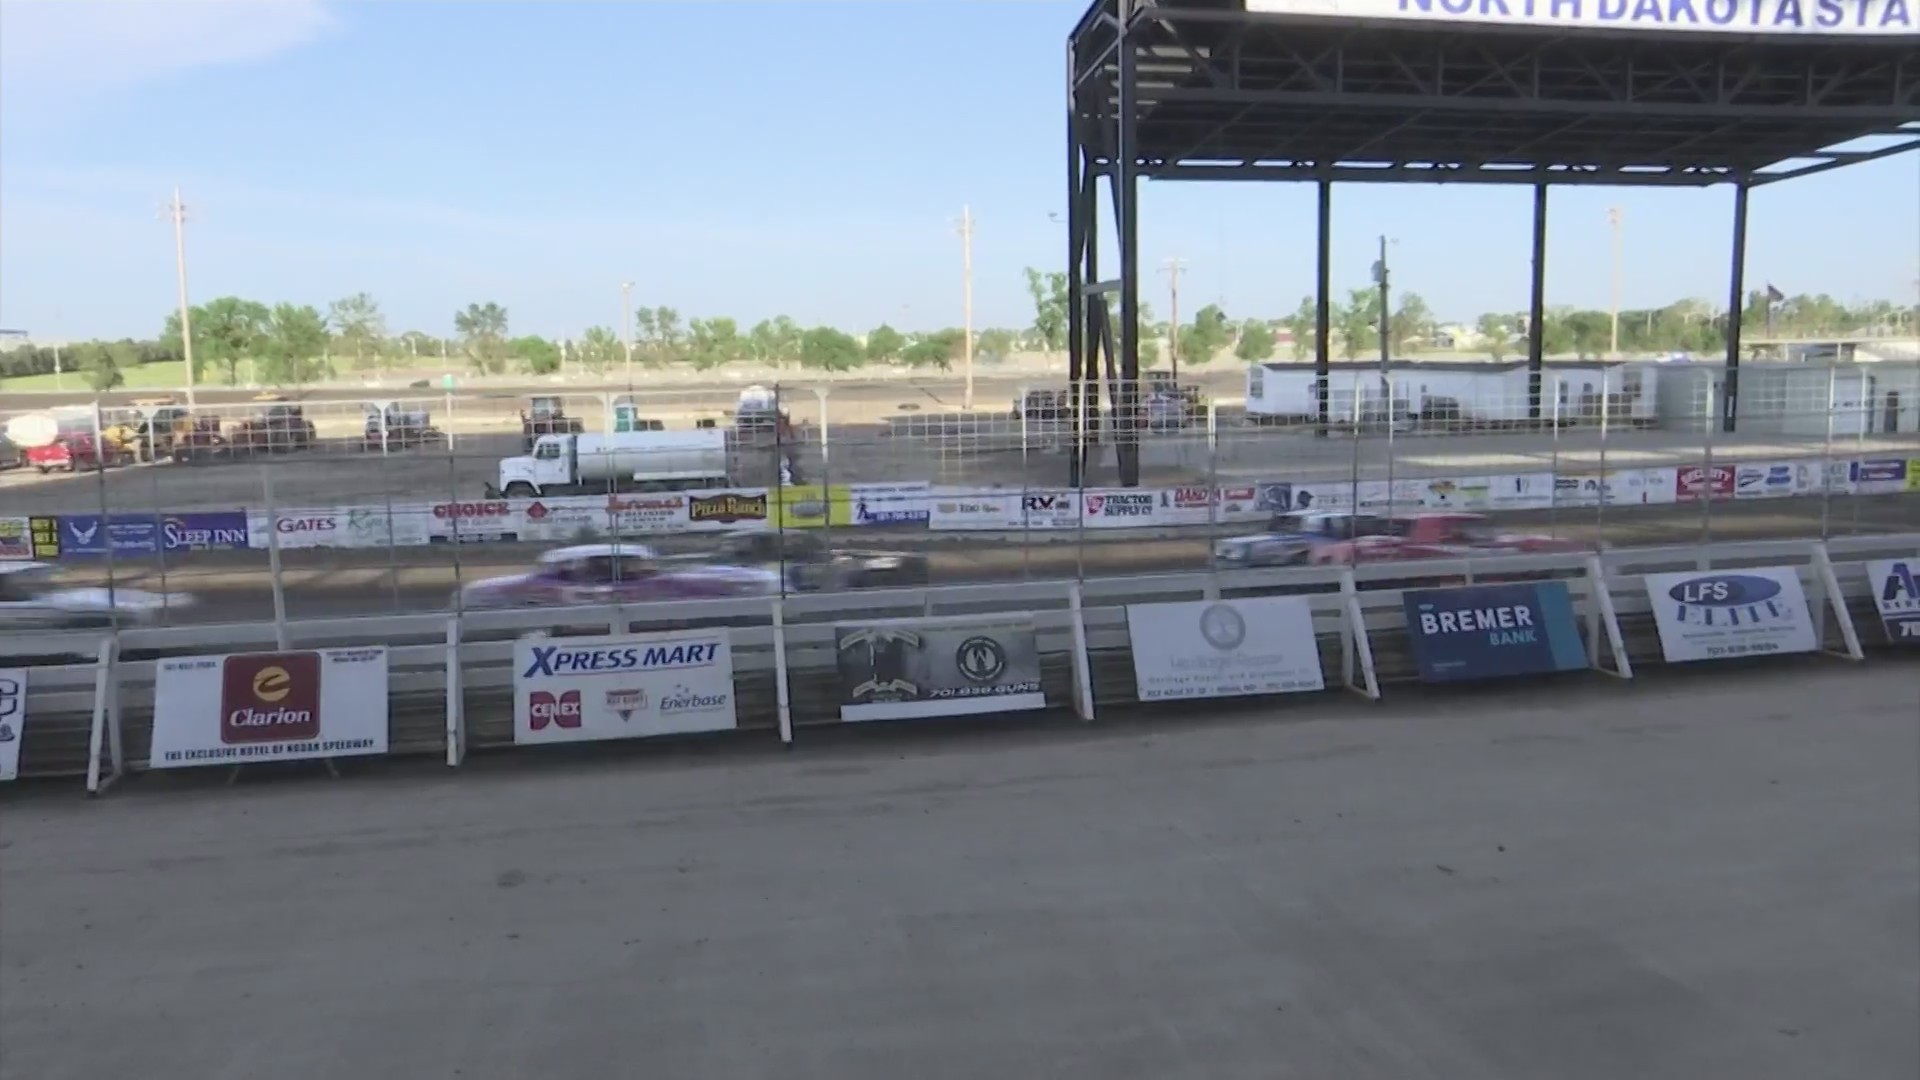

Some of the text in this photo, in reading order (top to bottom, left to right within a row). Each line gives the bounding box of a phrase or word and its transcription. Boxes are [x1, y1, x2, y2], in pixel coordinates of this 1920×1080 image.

[1597, 0, 1805, 26] DAKOTA
[1816, 0, 1911, 27] STA
[1681, 467, 1731, 485] SECITY
[1022, 496, 1055, 510] RV
[1104, 494, 1153, 504] TRACTOR
[433, 502, 510, 518] CHOICE
[1104, 505, 1139, 516] SUPPLY
[277, 516, 336, 533] GATES
[164, 523, 212, 550] SLEEP
[214, 528, 247, 544] INN
[1684, 581, 1729, 602] LFS
[1420, 605, 1533, 635] BREMER
[1490, 629, 1537, 646] BANK
[523, 642, 721, 678] XPRESS MART
[531, 702, 581, 717] CENEX
[660, 693, 727, 710] Enerbase
[229, 707, 311, 728] Clarion
[165, 750, 183, 761] THE
[185, 747, 237, 761] EXCLUSIVE
[240, 745, 270, 756] HOTEL
[272, 744, 284, 755] OF
[323, 738, 375, 751] SPEEDWAY
